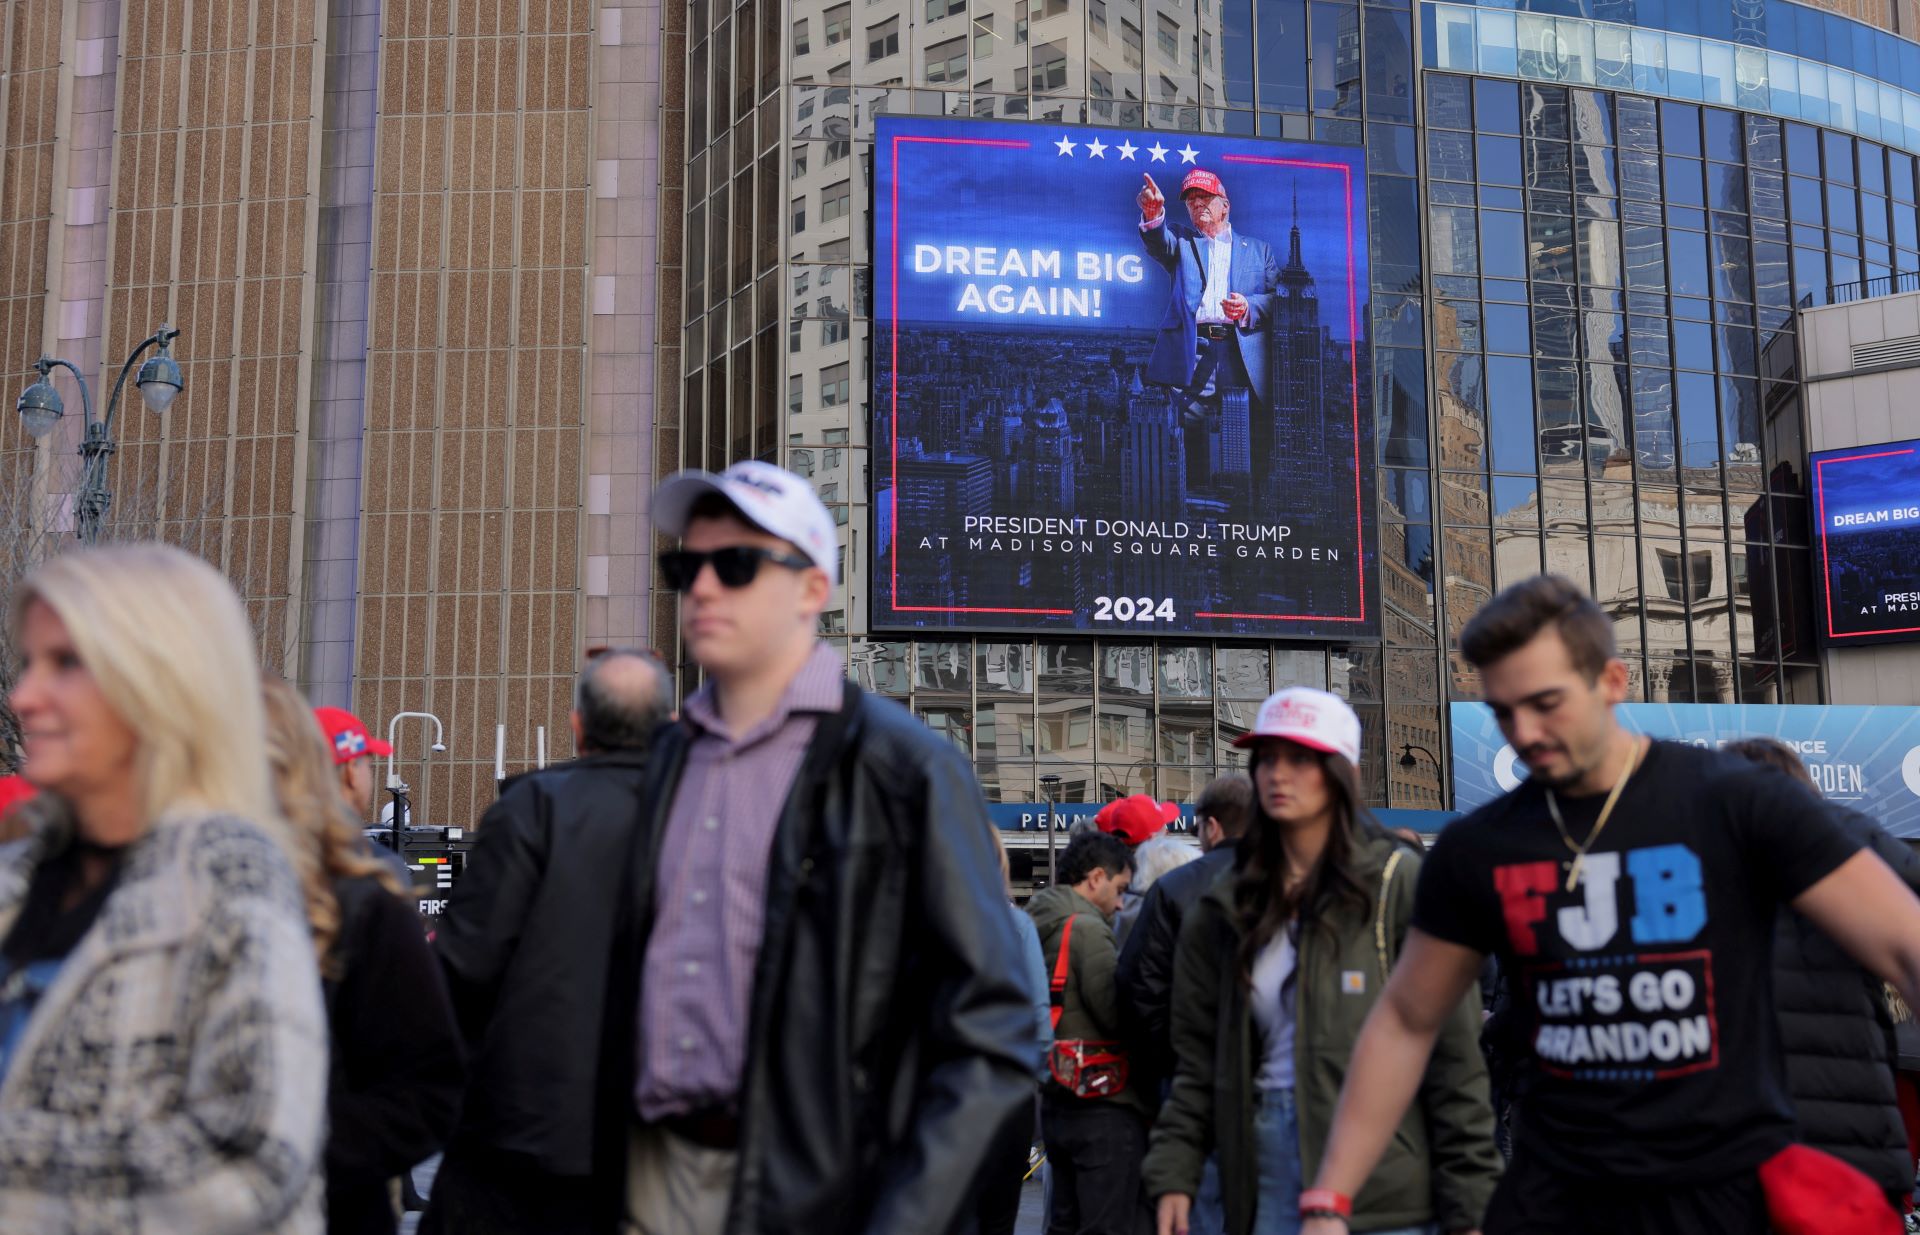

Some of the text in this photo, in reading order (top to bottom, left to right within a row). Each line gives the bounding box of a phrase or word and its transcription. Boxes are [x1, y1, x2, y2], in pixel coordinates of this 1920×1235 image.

[915, 244, 1144, 283] DREAM BIG
[956, 283, 1101, 318] AGAIN!
[964, 515, 1291, 542] PRESIDENT DONALD J. TRUMP
[1834, 507, 1920, 527] DREAM BIG
[919, 536, 1339, 561] AT MADISON SQUARE GARDEN
[1093, 596, 1177, 622] 2024
[1860, 605, 1877, 615] AT
[1809, 764, 1862, 793] RDEN
[1493, 842, 1708, 956] FJB
[1537, 969, 1696, 1016] LET'S GO
[1535, 1013, 1712, 1064] BRANDON
